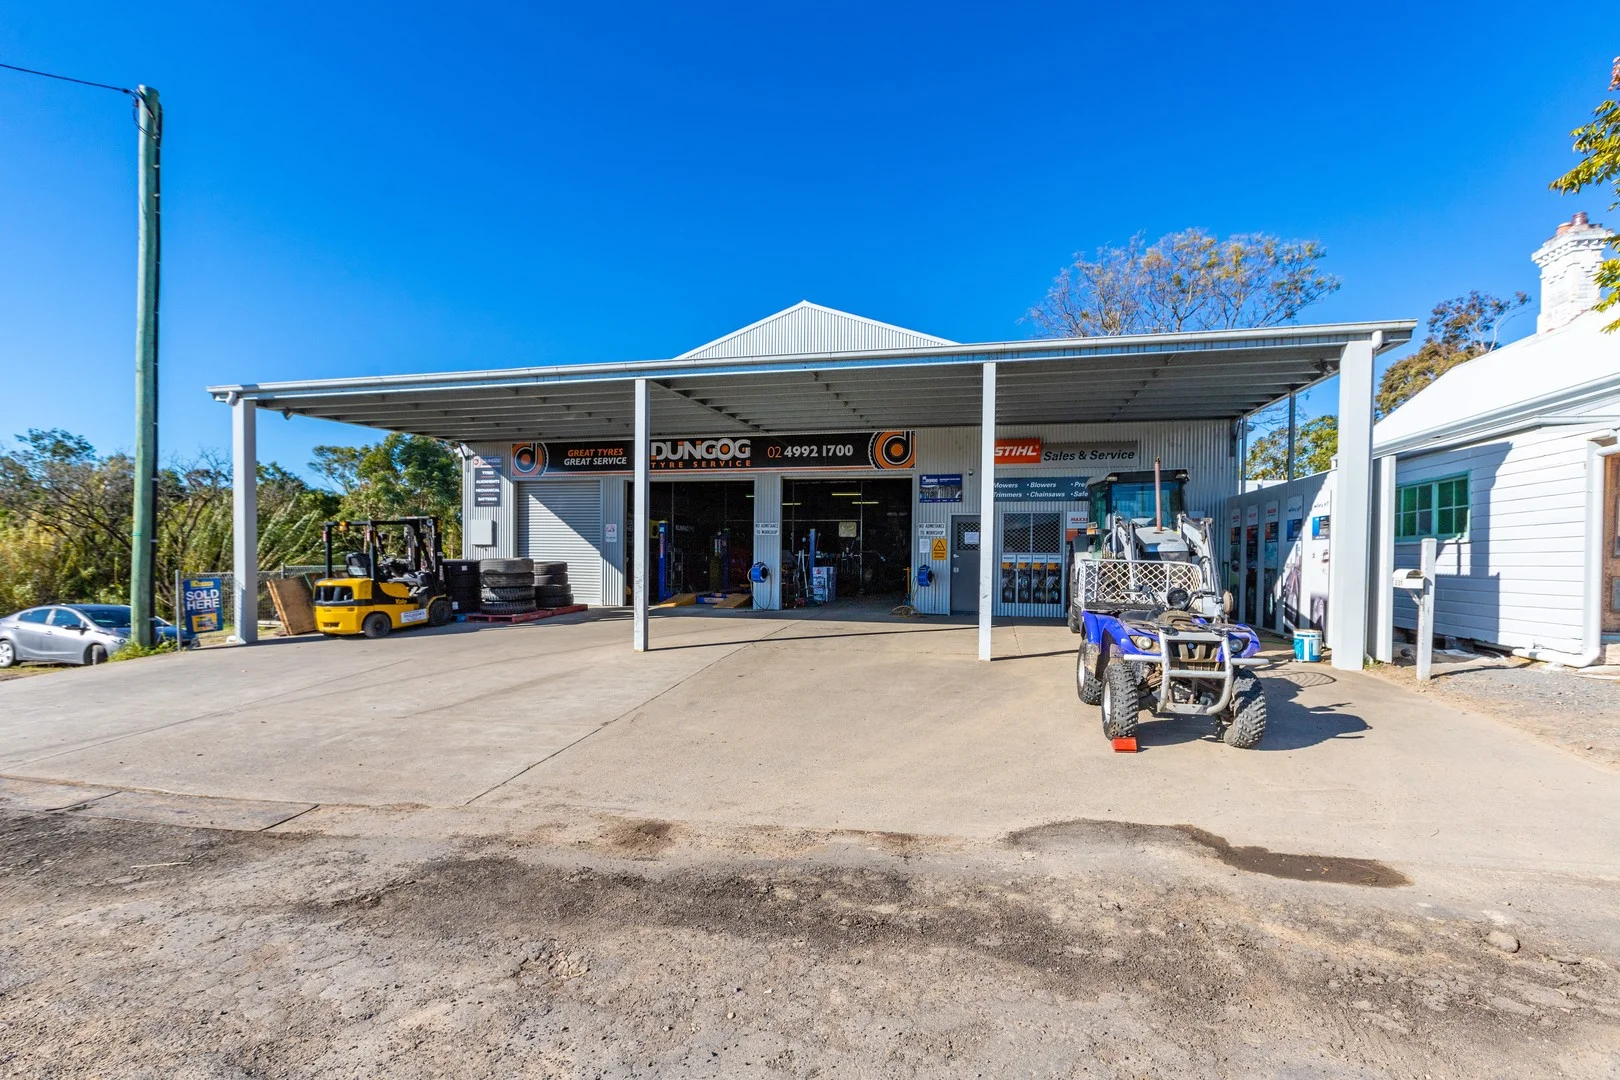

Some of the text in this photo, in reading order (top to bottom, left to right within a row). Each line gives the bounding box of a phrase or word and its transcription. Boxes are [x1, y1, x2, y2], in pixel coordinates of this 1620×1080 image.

[567, 447, 623, 457] GREAT TYRES
[650, 438, 751, 460] DUNGOG
[767, 445, 853, 458] 02 4992 1700
[994, 445, 1037, 457] STIHL
[1043, 449, 1135, 461] Sales & Service
[563, 456, 627, 466] GREAT SERVICE
[650, 460, 751, 469] TYRE SERVICE
[1029, 481, 1057, 489] Blowers
[1073, 490, 1088, 498] Safe
[186, 589, 220, 601] SOLD
[187, 598, 220, 611] HERE
